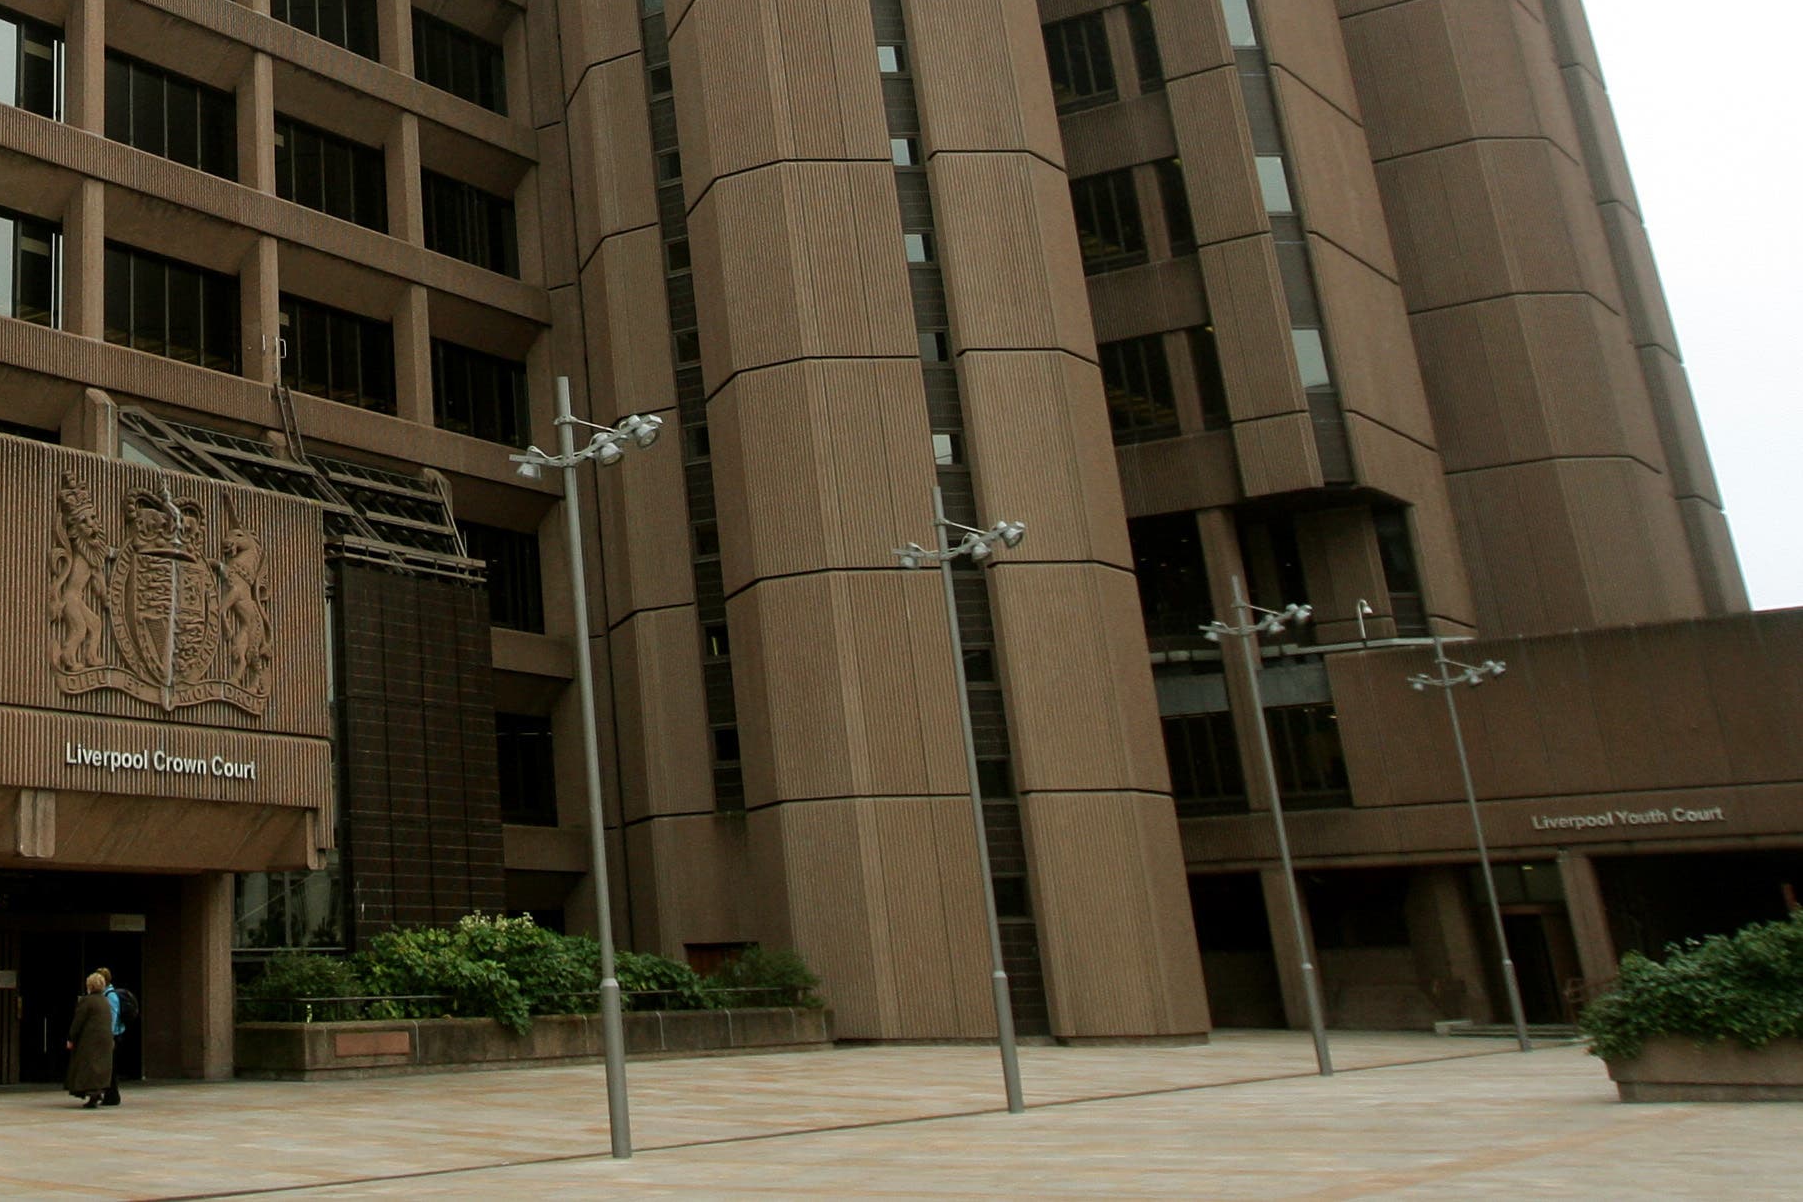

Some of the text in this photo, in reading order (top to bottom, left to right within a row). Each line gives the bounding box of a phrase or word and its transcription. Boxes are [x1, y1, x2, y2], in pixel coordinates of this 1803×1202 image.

[66, 673, 268, 714] DIEU ET MON DROIT
[66, 742, 256, 780] Liverpool Crown Court
[1531, 806, 1725, 830] Liverpool Youth Court
